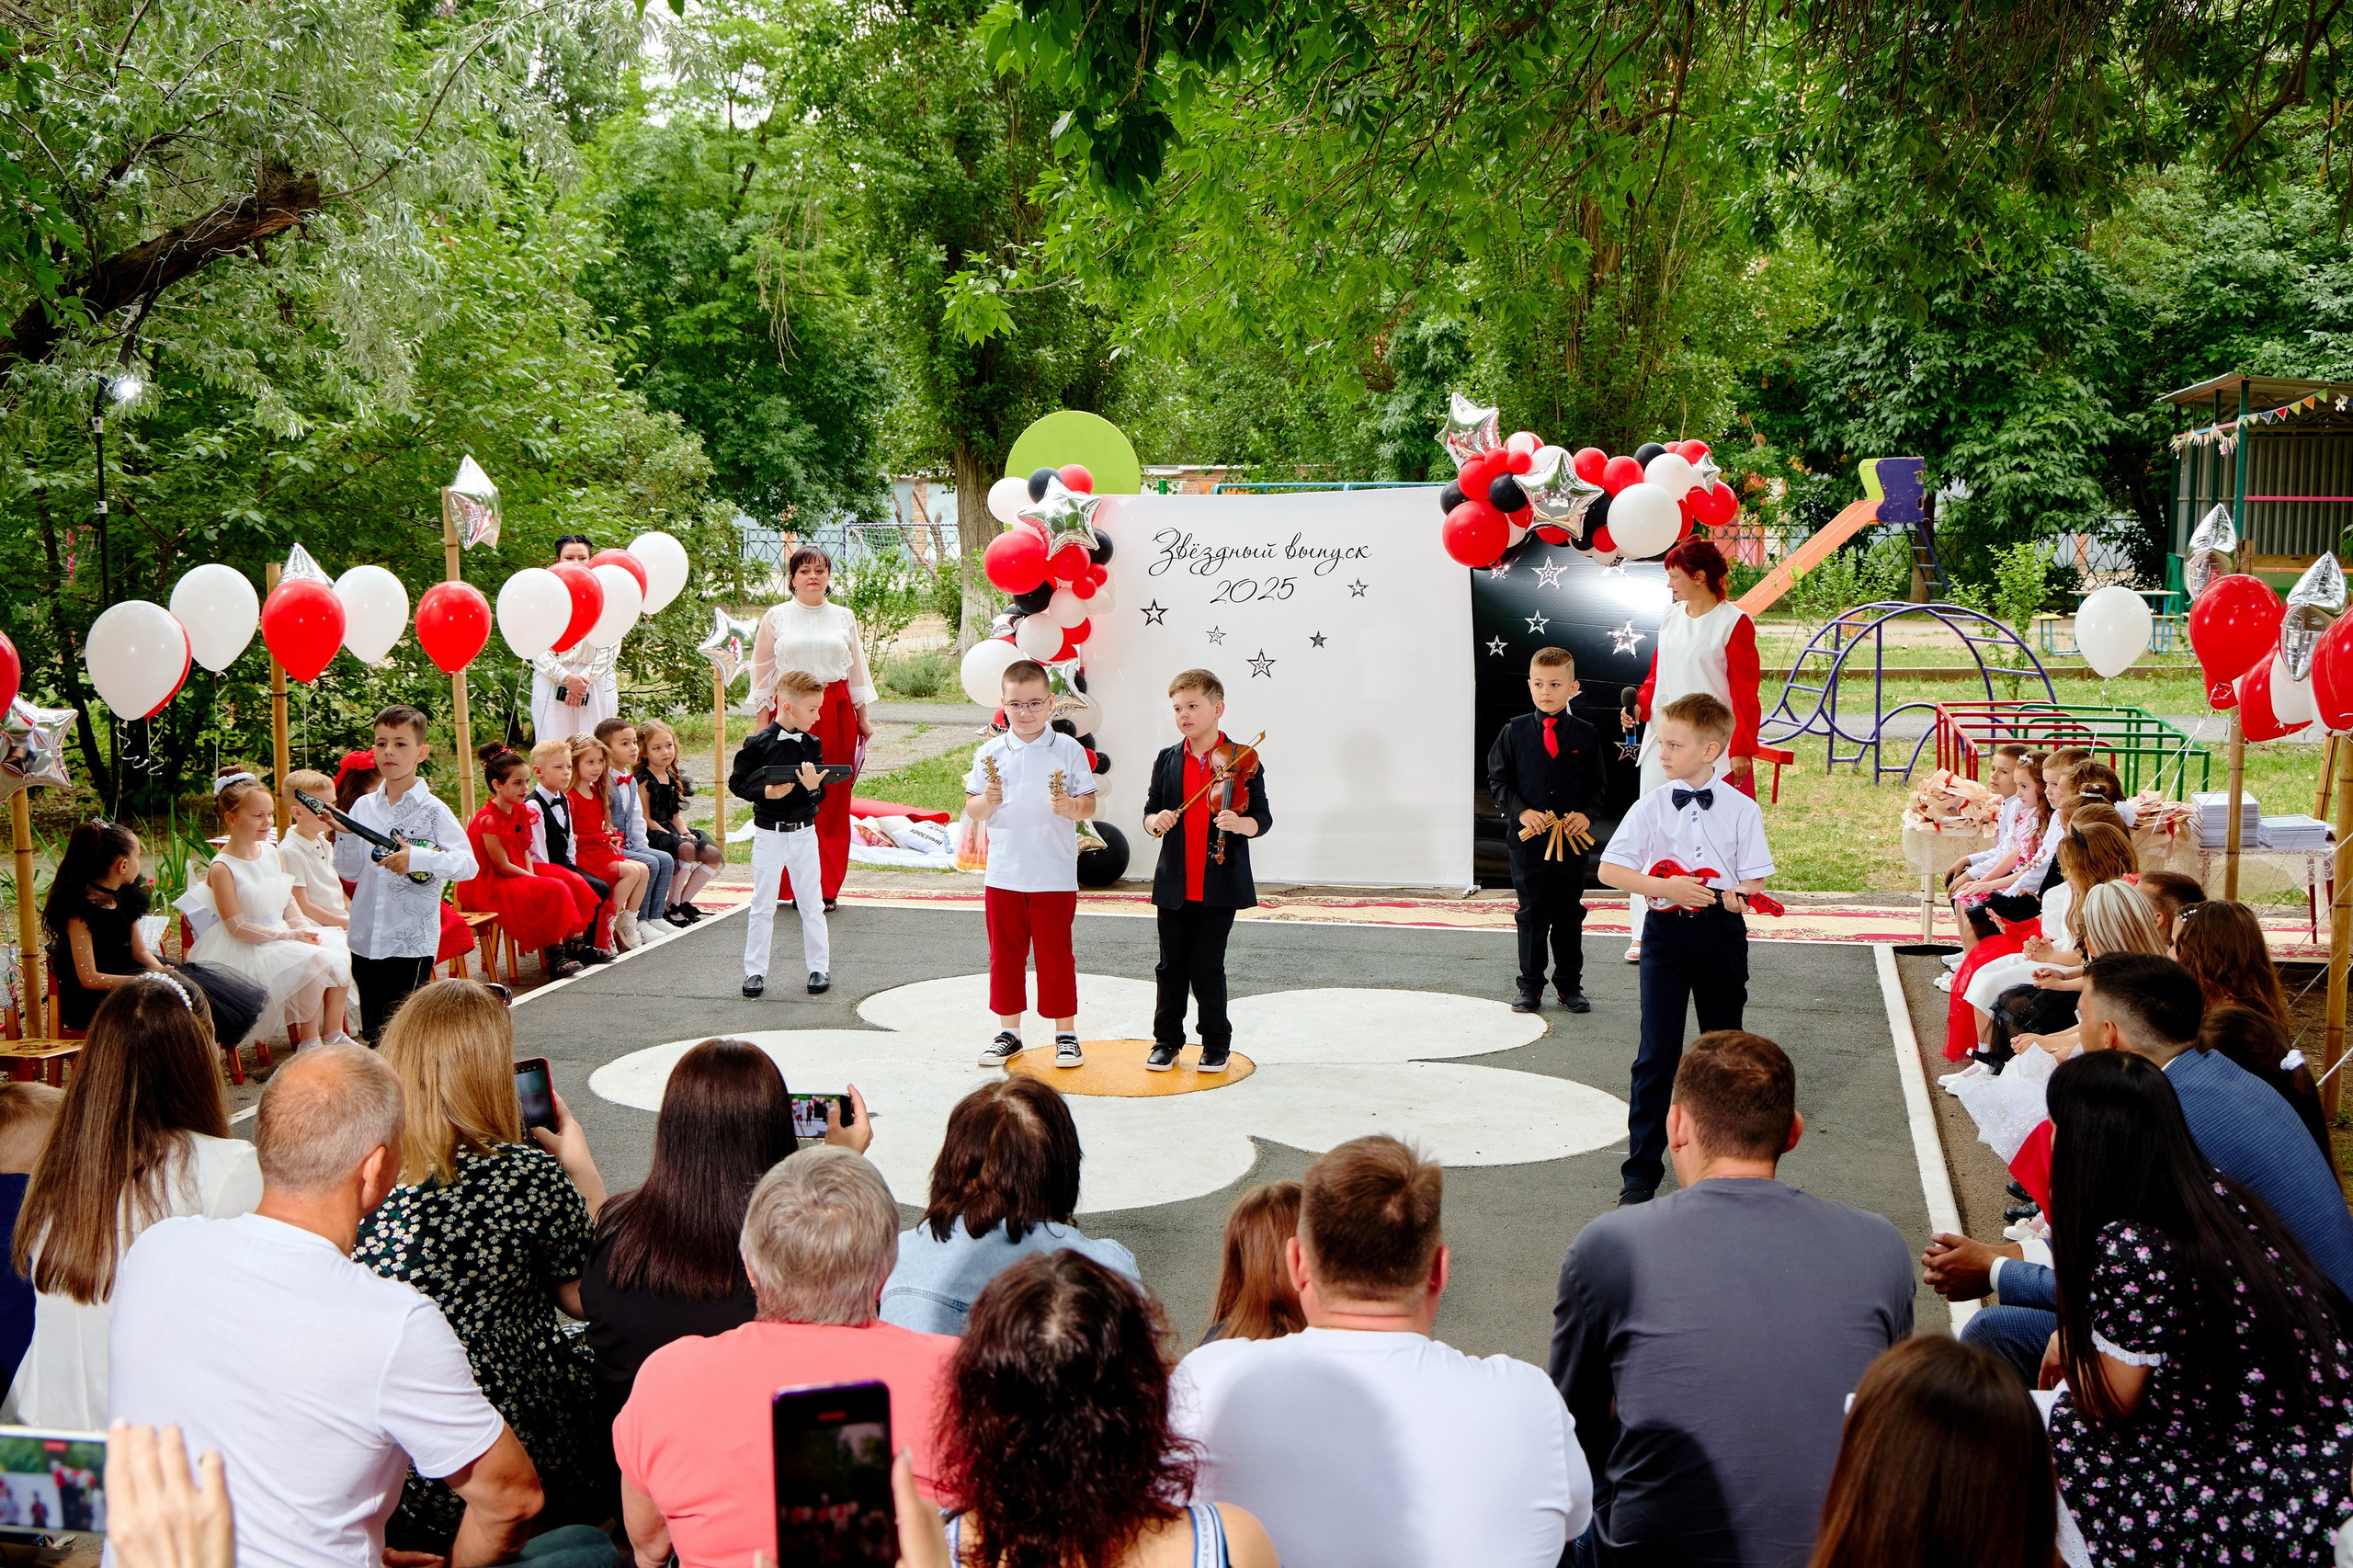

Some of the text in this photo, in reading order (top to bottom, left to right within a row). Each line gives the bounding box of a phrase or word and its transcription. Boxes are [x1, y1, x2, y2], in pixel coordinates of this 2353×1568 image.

[1148, 527, 1372, 576] Звёздный выпуск
[1210, 576, 1298, 604] 2025
